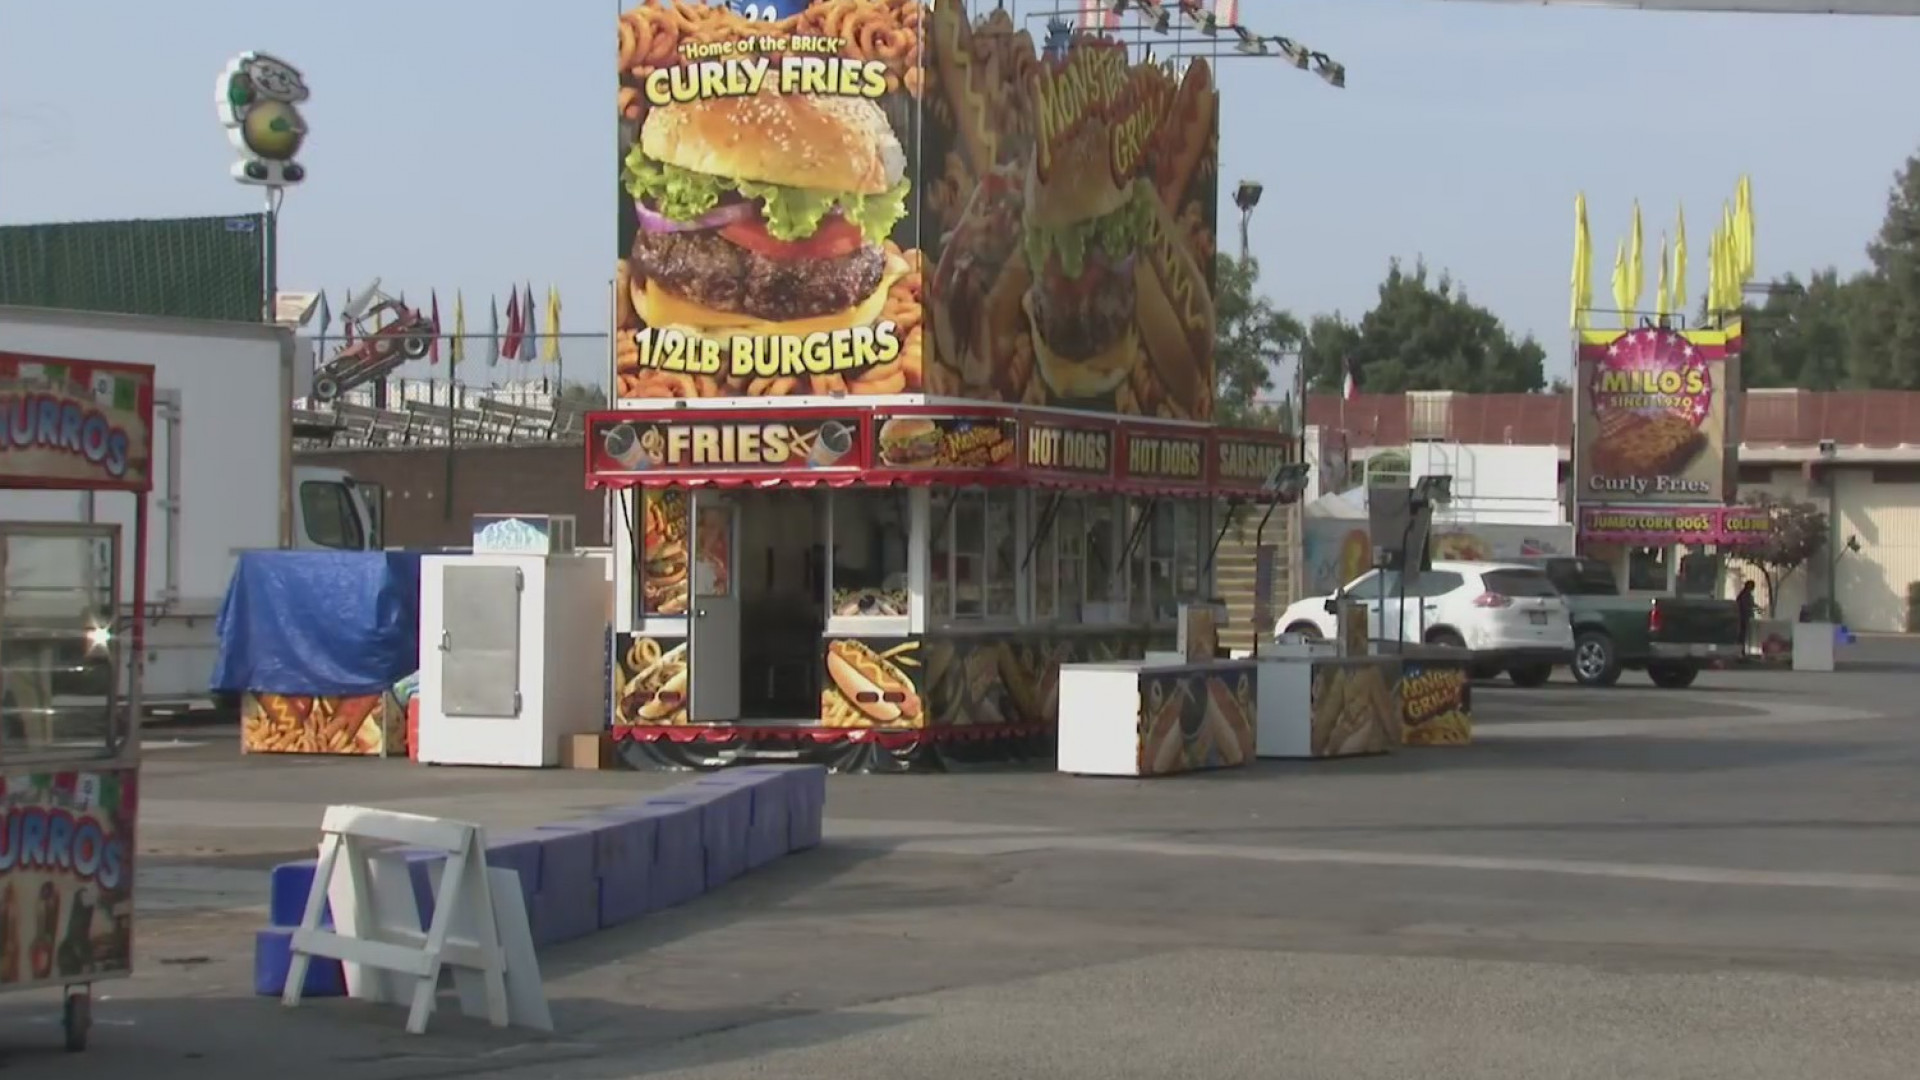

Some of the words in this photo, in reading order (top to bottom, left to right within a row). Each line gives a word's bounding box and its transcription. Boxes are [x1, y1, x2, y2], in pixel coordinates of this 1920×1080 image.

[678, 42, 733, 59] "Home
[738, 37, 755, 52] of
[759, 37, 786, 51] the
[791, 36, 846, 53] BRICK"
[645, 57, 769, 106] CURLY
[780, 56, 889, 98] FRIES
[1034, 43, 1129, 170] MONSTER
[635, 326, 721, 374] 1/2LB
[731, 320, 900, 377] BURGERS
[1601, 365, 1705, 394] MILO'S
[667, 423, 792, 465] FRIES
[1028, 426, 1062, 467] HOT
[1063, 430, 1107, 470] DOGS
[1129, 437, 1160, 473] HOT
[1161, 440, 1200, 476] DOGS
[1589, 474, 1648, 495] Curly
[1655, 474, 1710, 493] Fries
[1593, 516, 1636, 530] JUMBO
[1638, 516, 1672, 530] CORN
[1675, 516, 1710, 531] DOGS
